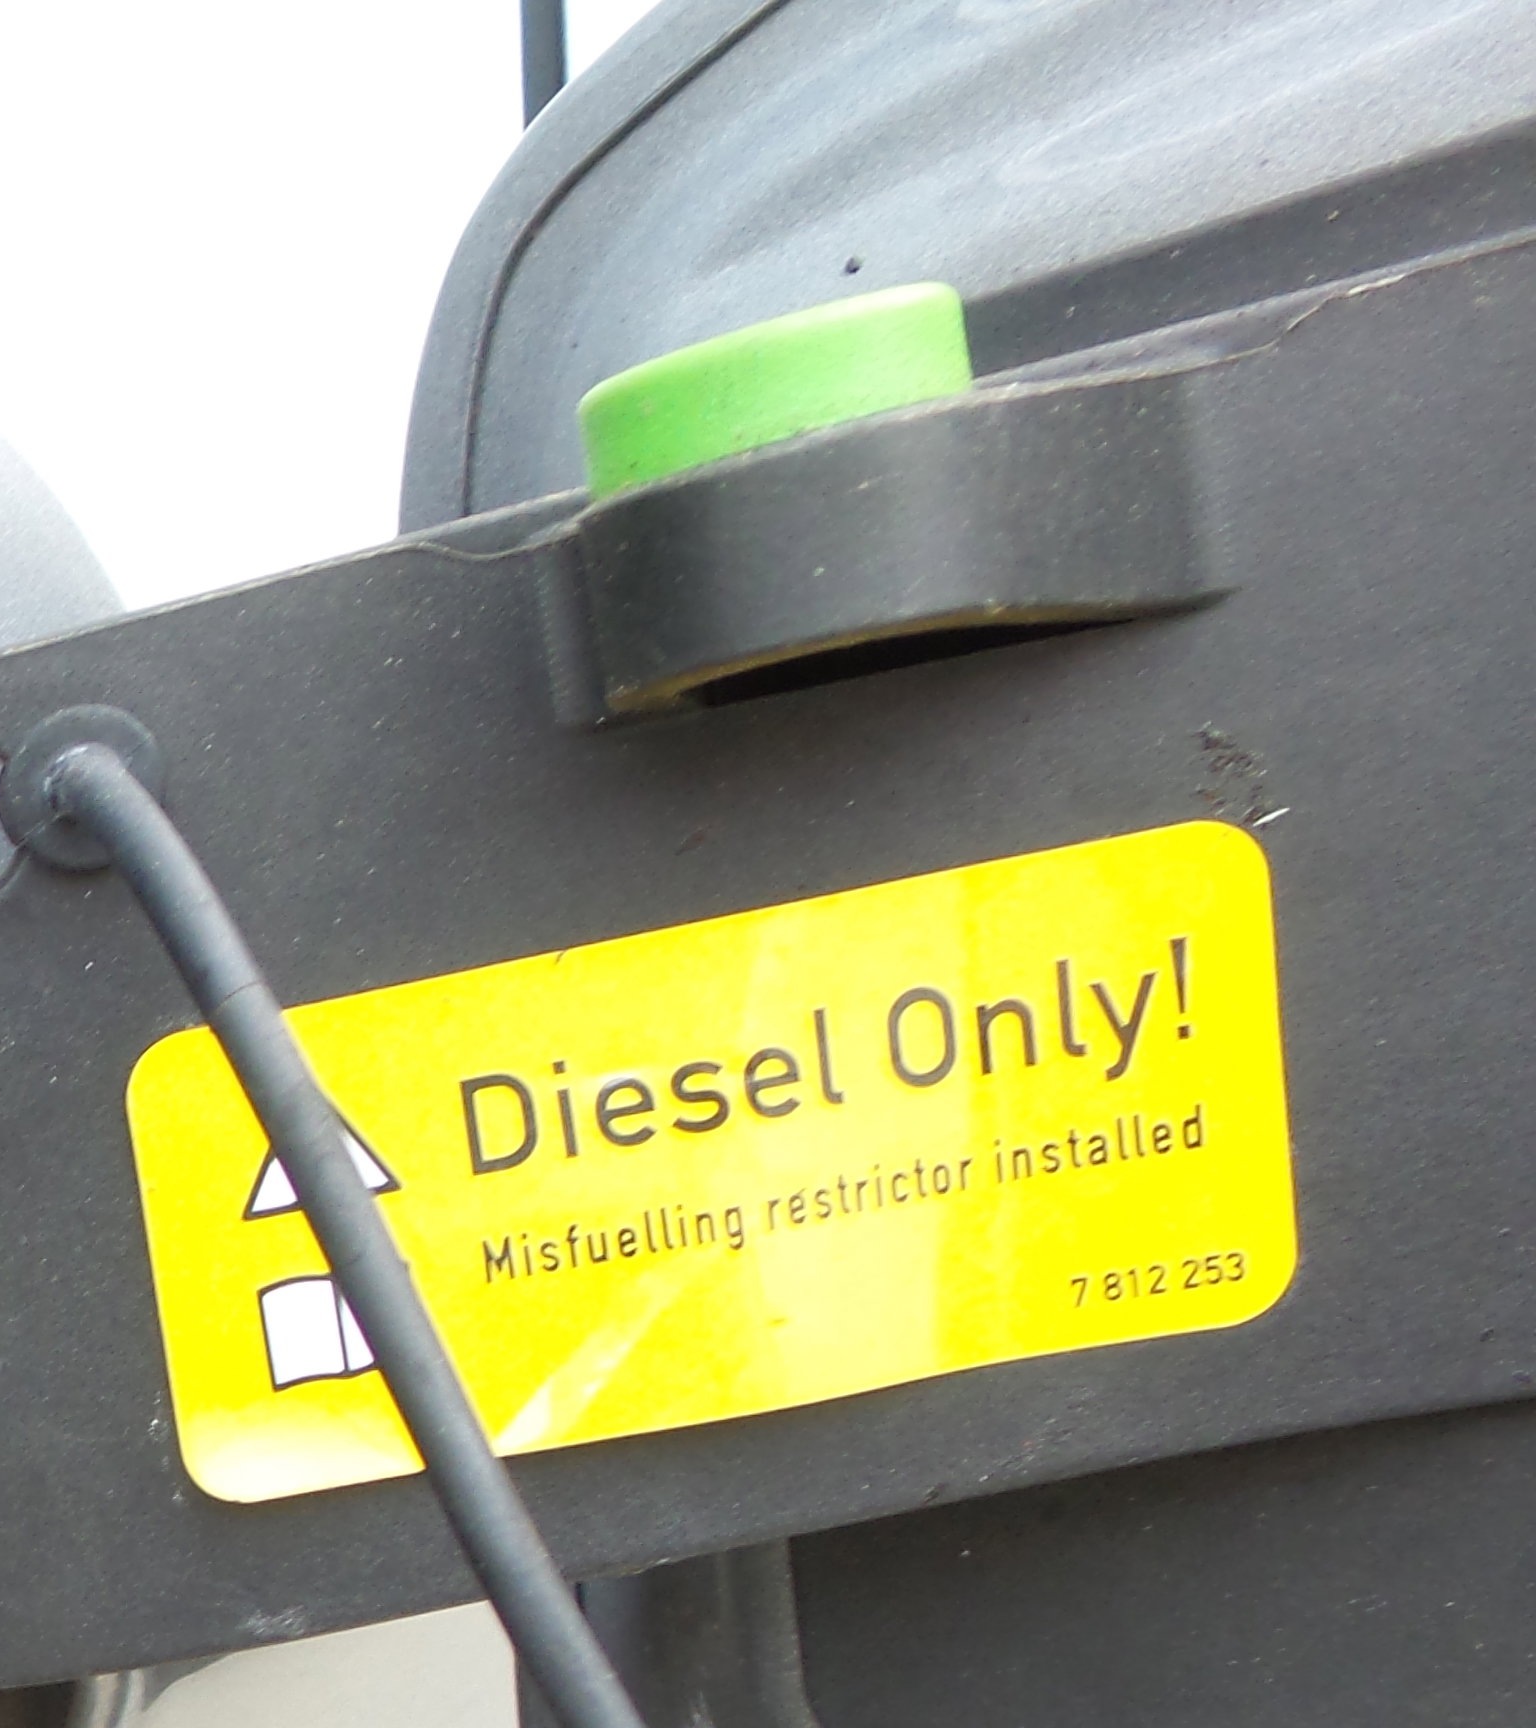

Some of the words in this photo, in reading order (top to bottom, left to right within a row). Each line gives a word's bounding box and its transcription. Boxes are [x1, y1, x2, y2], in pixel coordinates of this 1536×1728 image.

[458, 1007, 845, 1176] Diesel
[887, 937, 1192, 1088] Only!
[481, 1204, 746, 1284] Misfuelling
[766, 1156, 973, 1230] restrictor
[992, 1103, 1205, 1184] installed
[1070, 1277, 1089, 1308] 7
[1103, 1264, 1168, 1302] 812
[1182, 1251, 1247, 1291] 253
